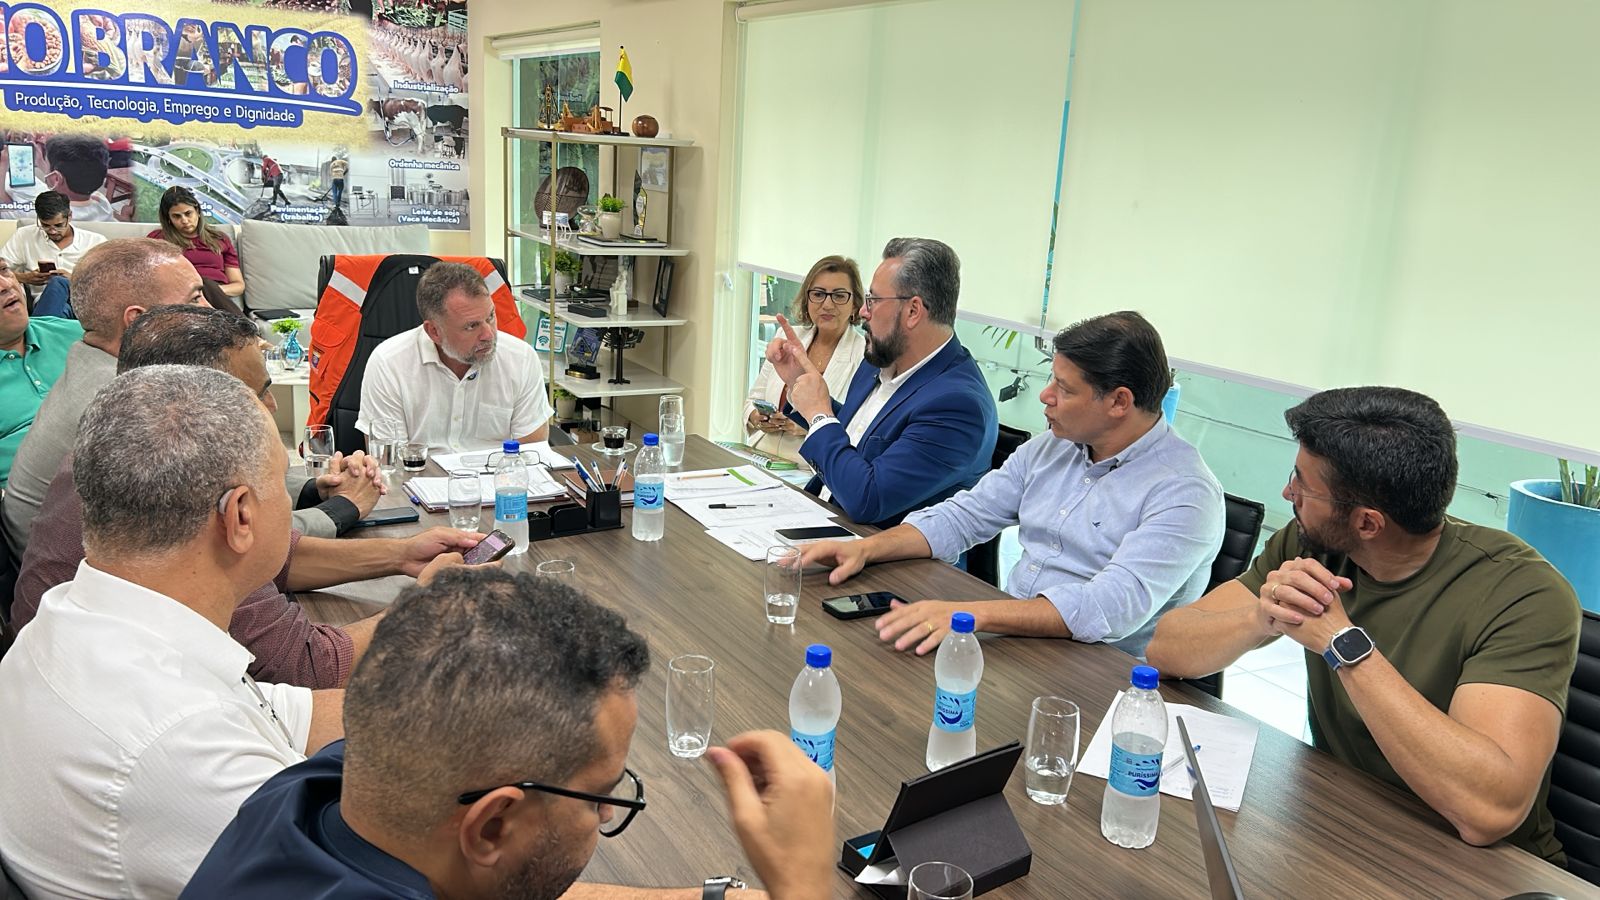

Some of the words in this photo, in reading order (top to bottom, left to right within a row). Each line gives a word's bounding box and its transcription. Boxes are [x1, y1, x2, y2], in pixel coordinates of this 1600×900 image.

[78, 14, 352, 98] BRANCO
[394, 81, 459, 94] Industrialização
[15, 92, 83, 110] Produção,
[87, 96, 160, 115] Tecnologia,
[164, 98, 220, 119] Emprego
[223, 109, 232, 118] e
[235, 105, 296, 122] Dignidade
[389, 160, 423, 170] Ordenha
[0, 201, 35, 212] nologi
[270, 205, 329, 215] Pavimentação
[280, 213, 323, 221] (trabalho)
